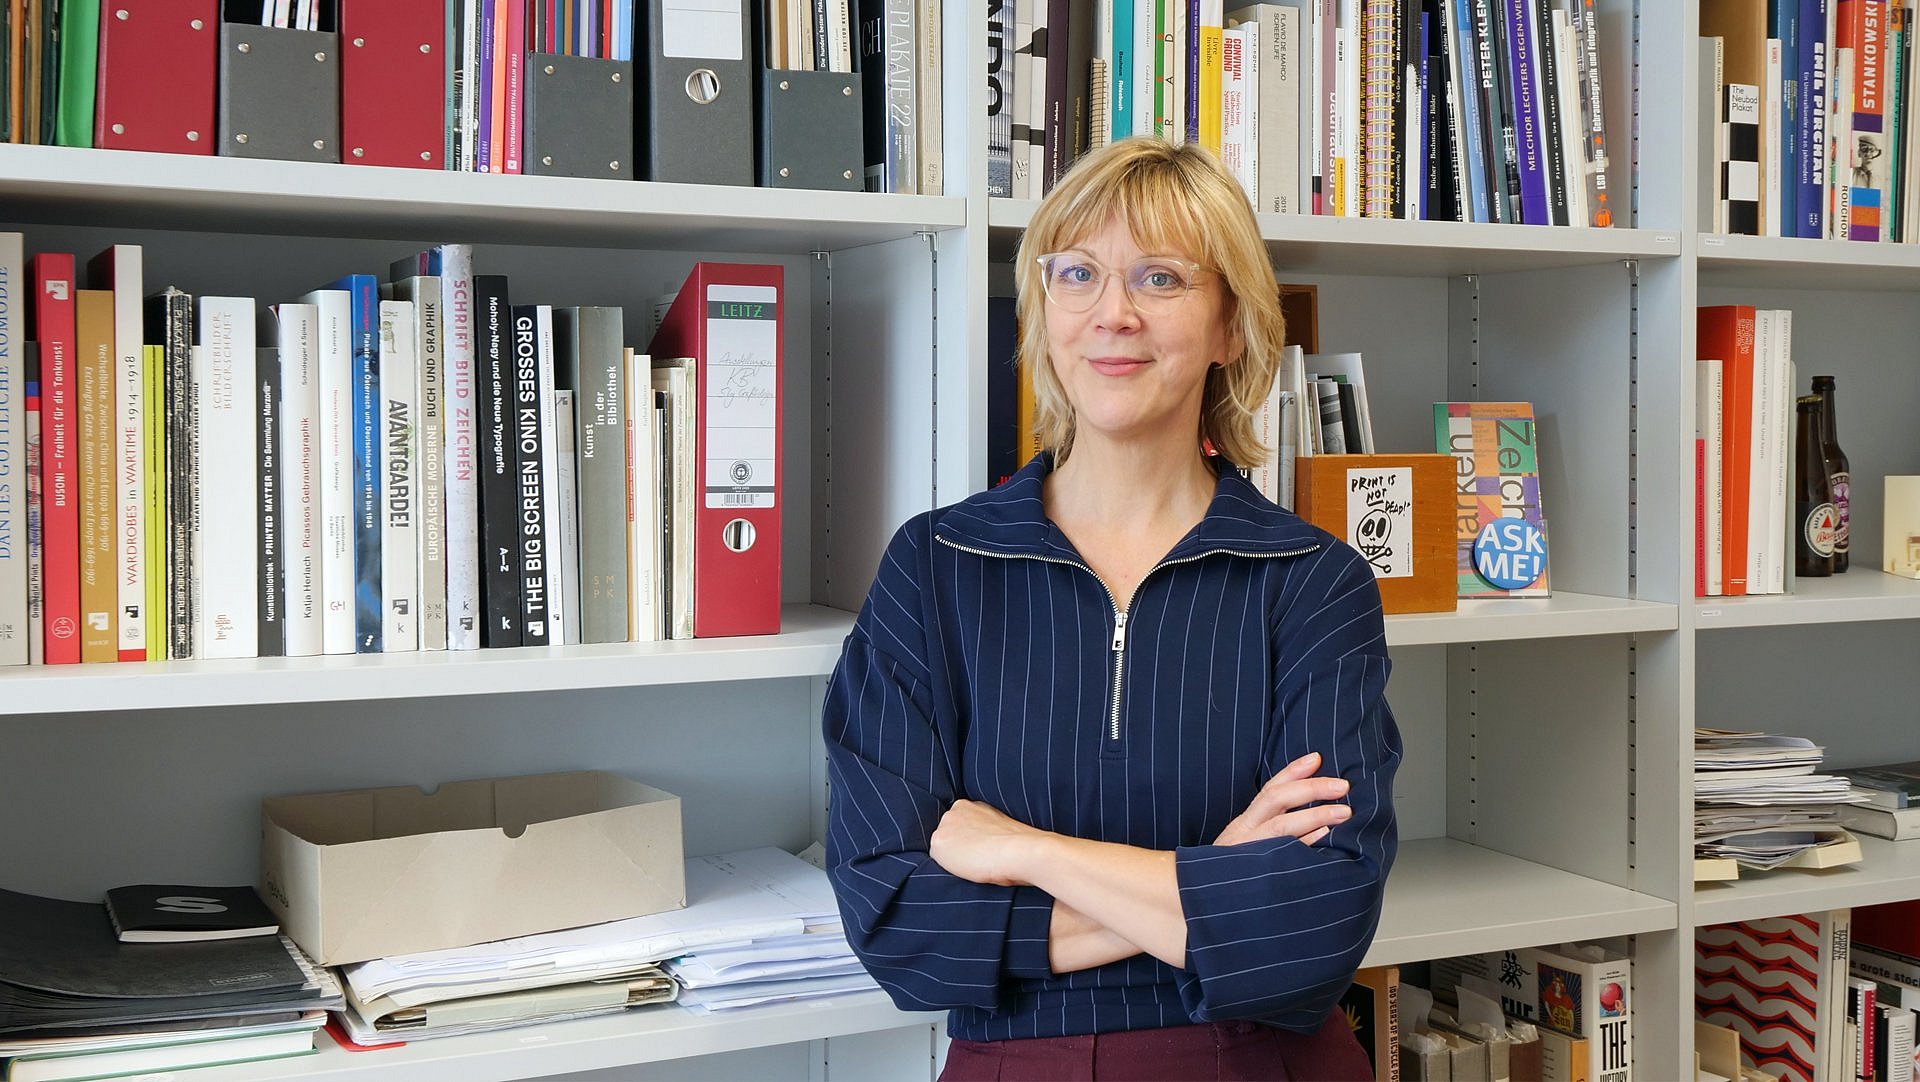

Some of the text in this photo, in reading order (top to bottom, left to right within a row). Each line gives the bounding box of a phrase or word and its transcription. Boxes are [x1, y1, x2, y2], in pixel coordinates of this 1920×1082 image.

[889, 10, 911, 99] PLAKATE
[1223, 38, 1233, 72] GROUND
[1232, 38, 1242, 82] CONVIVIAL
[1280, 41, 1287, 52] DE
[1478, 41, 1494, 89] PETER
[1546, 50, 1554, 86] Klingspor
[1586, 11, 1602, 132] Gebrauchsgrafik und Fotografie
[1519, 62, 1532, 114] LECHTERS
[1732, 86, 1745, 95] The
[1732, 94, 1758, 105] Neubad
[1802, 81, 1810, 129] Universalkünstler
[890, 103, 912, 127] 22
[1732, 103, 1753, 112] Plakat
[1525, 115, 1537, 172] MELCHIOR
[1553, 151, 1561, 180] Plakate
[1801, 149, 1810, 184] Jahrhunderts
[1494, 191, 1502, 220] WIENAND
[1840, 185, 1849, 239] ROUCHON
[721, 303, 764, 318] LEITZ
[173, 309, 185, 415] PLAKATE AUS ISRAEL
[363, 333, 371, 358] Plakate
[98, 343, 109, 403] Wechselblicke.
[363, 360, 371, 373] aus
[454, 279, 471, 481] SCHRIFT BILD ZEICHEN
[83, 366, 94, 411] Exchanging
[364, 374, 372, 409] Österreich
[489, 296, 505, 475] Moholy-Nagy und die Neue Typografie
[516, 316, 538, 454] GROSSES KINO
[606, 365, 618, 425] Bibliothek
[52, 340, 66, 507] BUSONI Freiheit für die Tonkunst!
[99, 403, 109, 440] Zwischen
[364, 411, 372, 424] und
[595, 391, 605, 425] in der
[424, 302, 439, 562] EUROPÄISCHE MODERNE BUCH UND GRAPHIK
[584, 423, 595, 458] Kunst
[85, 441, 94, 475] Between
[99, 442, 109, 465] China
[125, 426, 137, 485] WARTIME
[300, 417, 311, 504] Gebrauchsgraphik
[389, 399, 409, 529] AVANTGARDE!
[85, 476, 94, 500] China
[99, 467, 109, 482] und
[365, 483, 373, 499] 1914
[1351, 474, 1396, 492] PRINT IS
[86, 501, 95, 517] and
[99, 484, 110, 512] Europa
[128, 489, 137, 500] in
[262, 384, 274, 622] Kunstbibliothek PRINTED MATTER Die Sammlung Marzona
[365, 500, 373, 511] bis
[1366, 488, 1388, 503] NOT
[0, 483, 10, 560] DANTES
[85, 517, 95, 546] Europe
[302, 506, 311, 549] Picassos
[521, 460, 544, 614] THE BIG SCREEN
[1477, 523, 1545, 554] ASK
[125, 505, 137, 586] WARDROBES
[303, 556, 312, 592] Herlach
[1478, 551, 1540, 582] ME!
[176, 591, 186, 617] BERLIN
[303, 595, 312, 619] Katja
[176, 623, 186, 645] SMPK
[501, 616, 511, 631] k
[153, 896, 229, 914] S
[1391, 1023, 1399, 1034] OF
[1391, 1036, 1400, 1065] BICYCLE
[1599, 1021, 1628, 1072] THE
